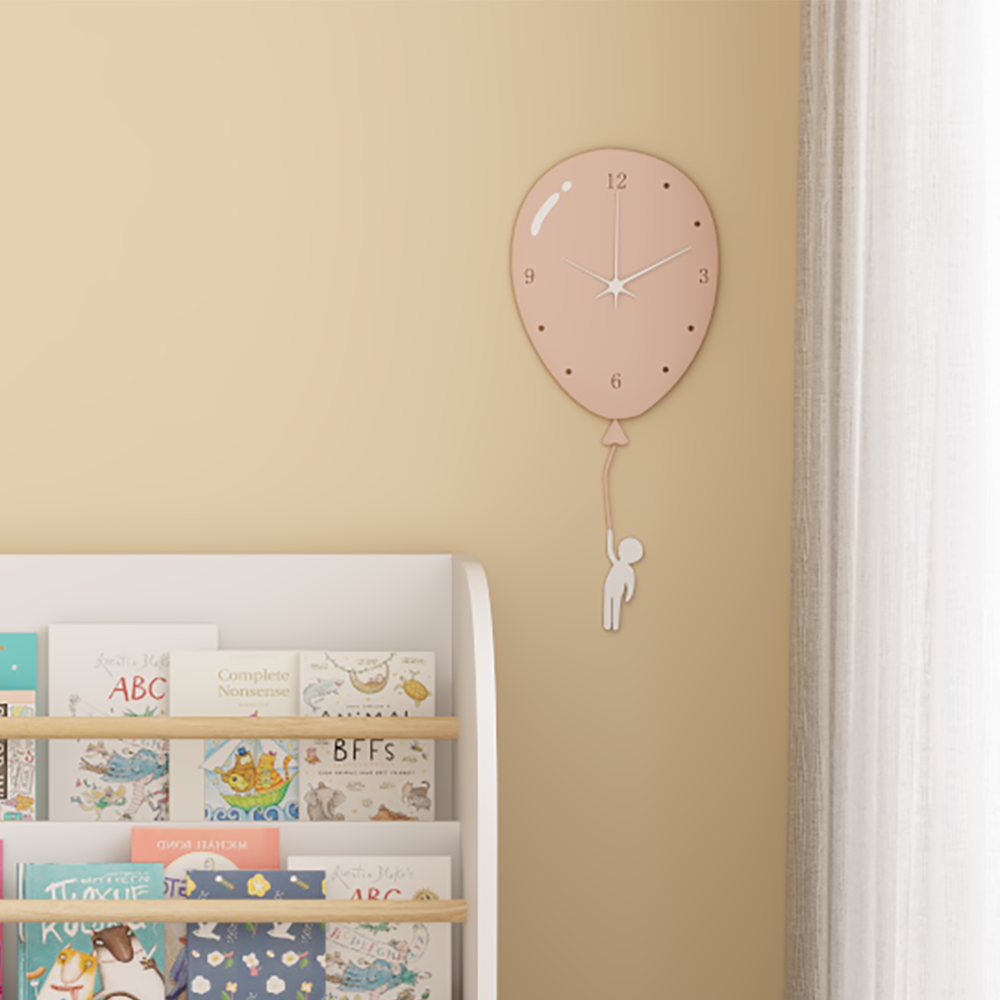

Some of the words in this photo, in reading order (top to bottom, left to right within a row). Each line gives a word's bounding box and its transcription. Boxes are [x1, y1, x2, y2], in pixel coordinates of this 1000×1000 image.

[607, 172, 628, 190] 12
[524, 268, 535, 285] 9
[698, 268, 710, 285] 3
[610, 372, 622, 390] 6
[217, 668, 290, 684] Complete
[108, 675, 167, 702] ABC
[217, 684, 291, 698] Nonsense
[333, 738, 396, 762] BFFs
